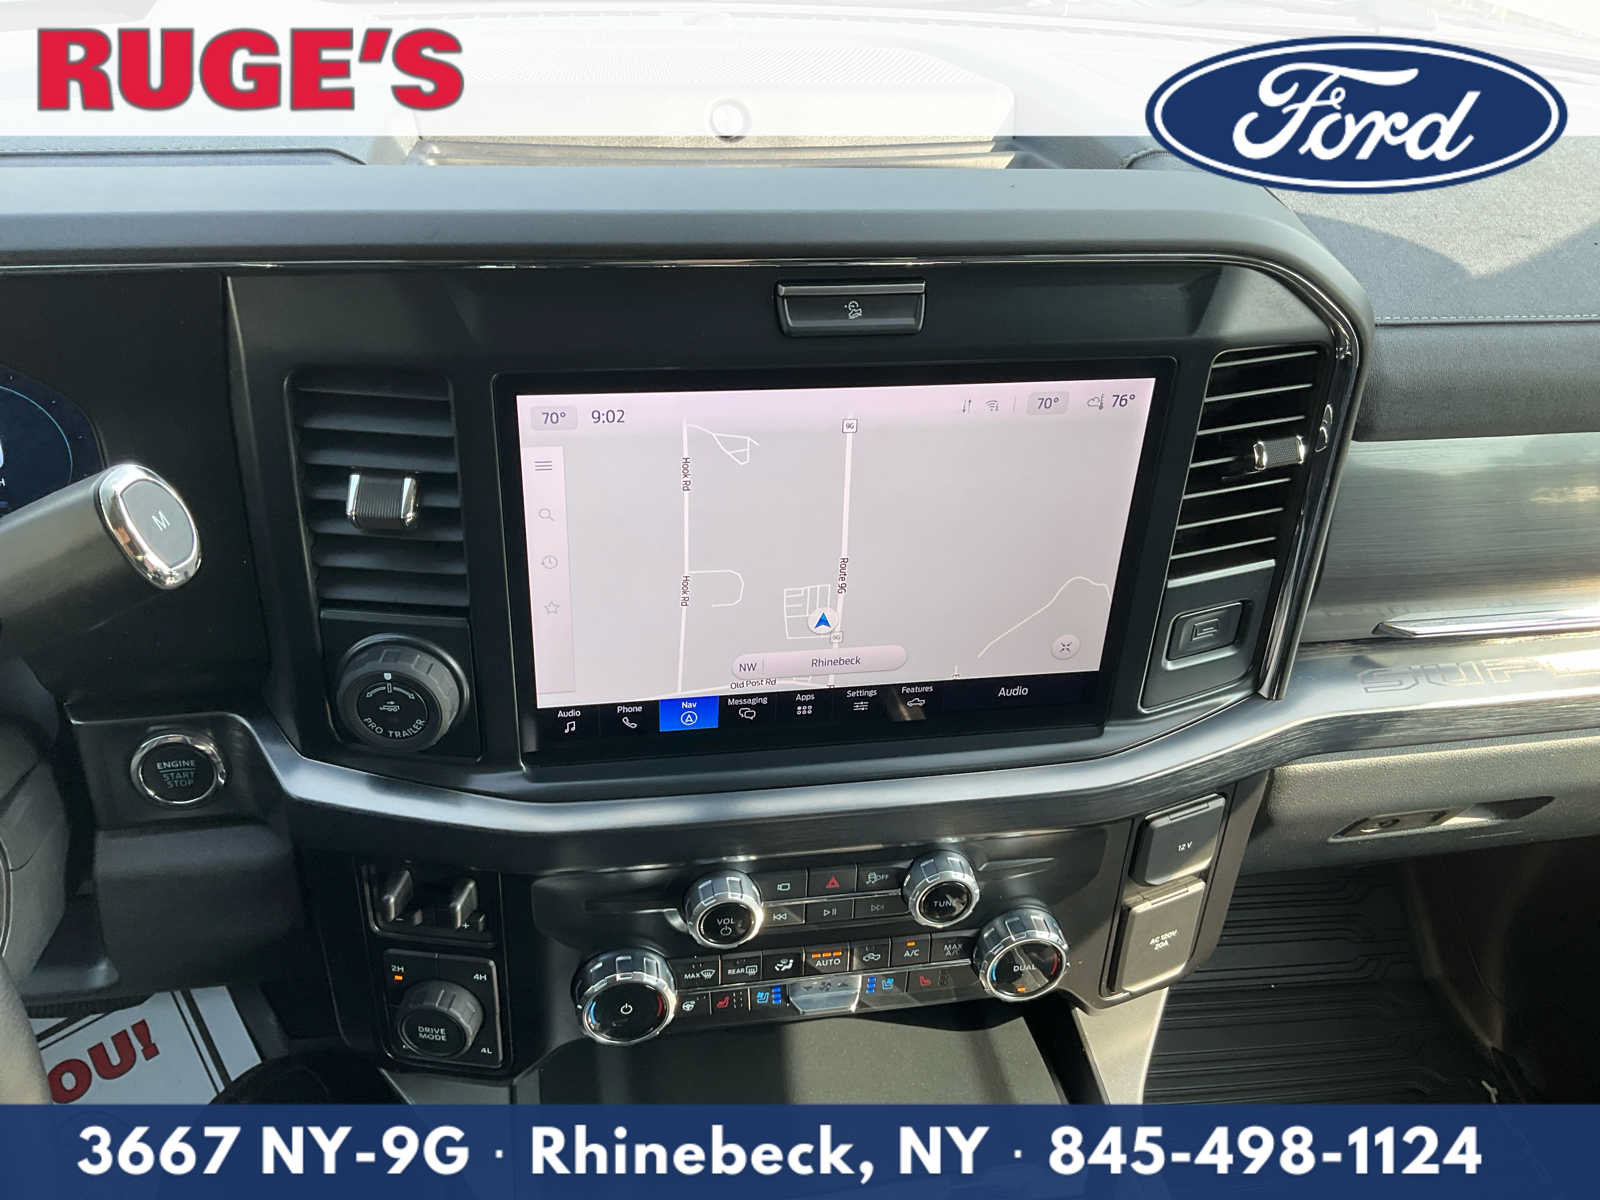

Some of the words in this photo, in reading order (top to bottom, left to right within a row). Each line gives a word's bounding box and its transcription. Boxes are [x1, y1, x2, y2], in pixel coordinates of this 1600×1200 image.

[1037, 396, 1060, 410] 70°
[1111, 393, 1136, 408] 76°
[541, 411, 566, 425] 70°
[591, 409, 625, 425] 9:02
[682, 457, 691, 480] Hook
[682, 480, 691, 492] Rd
[151, 511, 171, 532] M
[838, 557, 849, 582] Route
[681, 575, 690, 597] Hook
[837, 582, 848, 594] 9G
[680, 596, 689, 607] Rd
[739, 662, 757, 672] NW
[811, 656, 861, 668] Rhinebeck
[730, 680, 745, 690] Old
[747, 679, 764, 689] Post
[765, 677, 777, 687] Rd
[846, 688, 878, 698] Settings
[901, 685, 934, 694] Features
[998, 686, 1029, 697] Audio
[728, 696, 768, 708] Messaging
[796, 692, 815, 704] Apps
[617, 704, 643, 714] Phone
[681, 700, 697, 710] Nav
[557, 708, 581, 719] Audio
[363, 717, 384, 735] PRO
[387, 718, 425, 738] TRAILER
[156, 759, 196, 770] ENGINE
[162, 771, 195, 781] START
[166, 779, 194, 789] STOP
[716, 918, 736, 926] VOL
[903, 948, 920, 957] A/C
[943, 943, 963, 951] MAX
[815, 958, 841, 967] AUTO
[391, 965, 405, 973] 2H
[728, 967, 745, 975] REAR
[1013, 964, 1037, 973] DUAL
[473, 974, 488, 982] 4H
[684, 972, 701, 980] MAX
[417, 1025, 446, 1035] DRIVE
[418, 1032, 447, 1042] MODE
[480, 1047, 493, 1055] 4L
[48, 1018, 160, 1104] OU!
